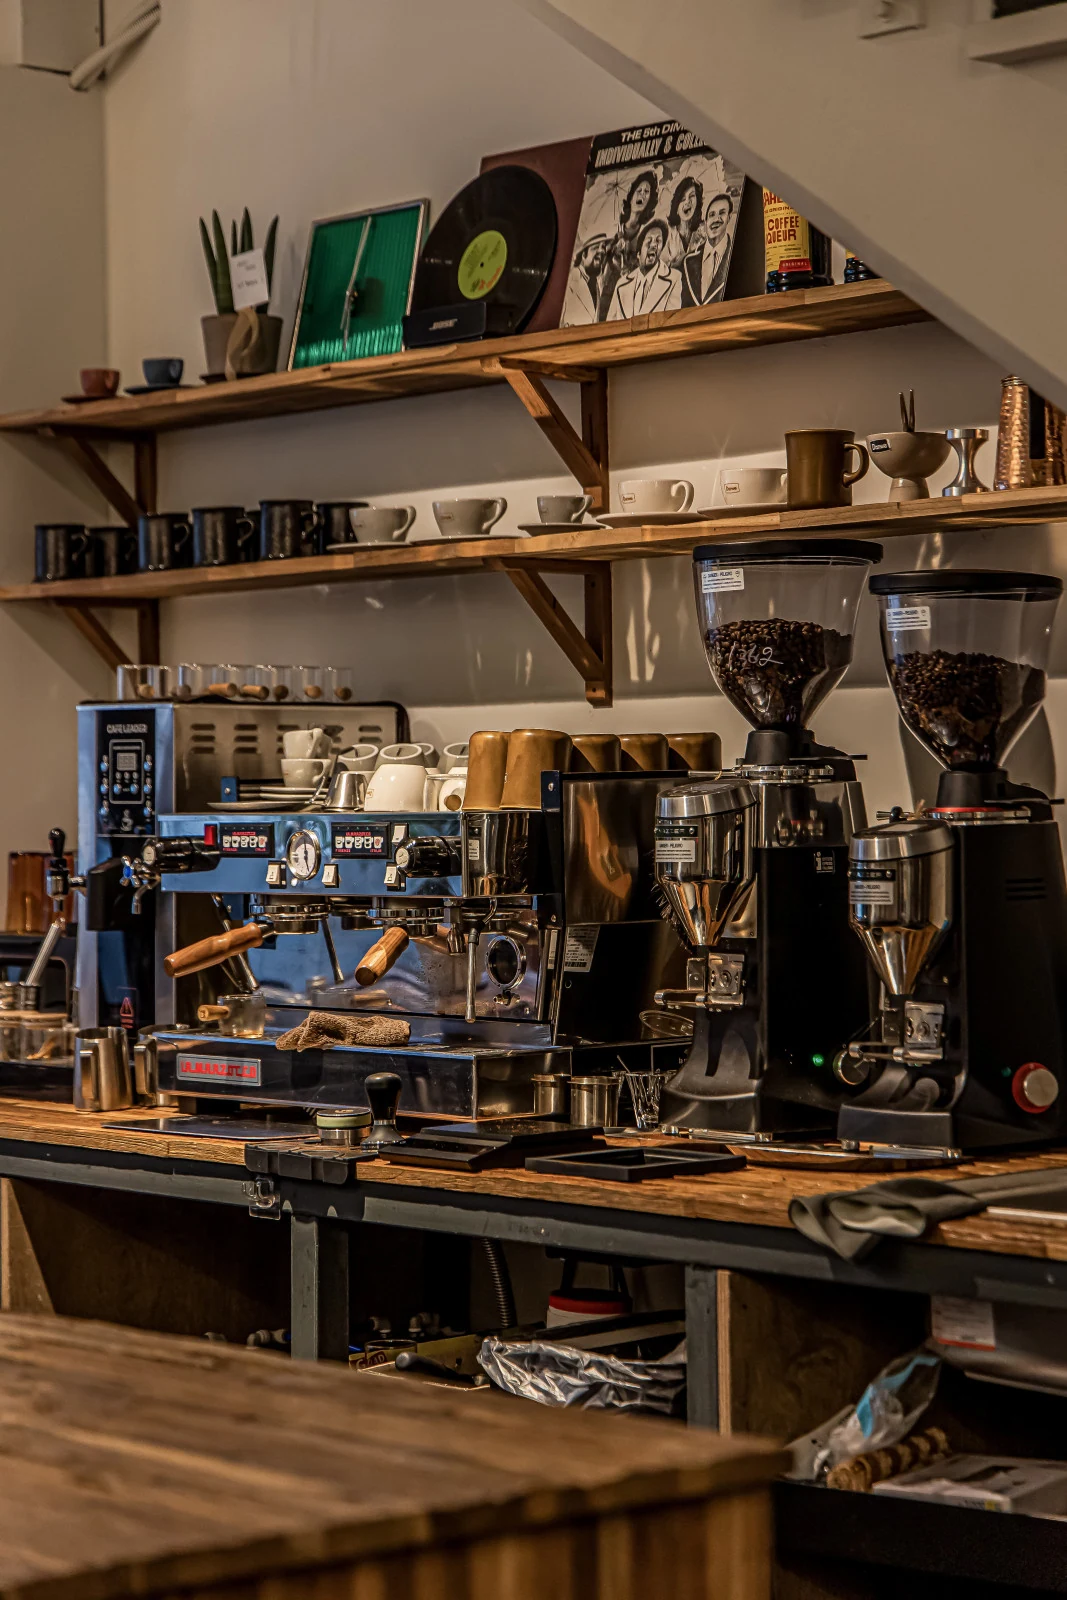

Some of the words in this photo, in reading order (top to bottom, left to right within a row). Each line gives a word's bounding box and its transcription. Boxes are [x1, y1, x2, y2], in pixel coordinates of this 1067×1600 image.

[621, 129, 641, 143] THE
[643, 127, 660, 138] 5th
[595, 138, 662, 168] INDIVIDUALLY
[768, 215, 799, 231] COFFEE
